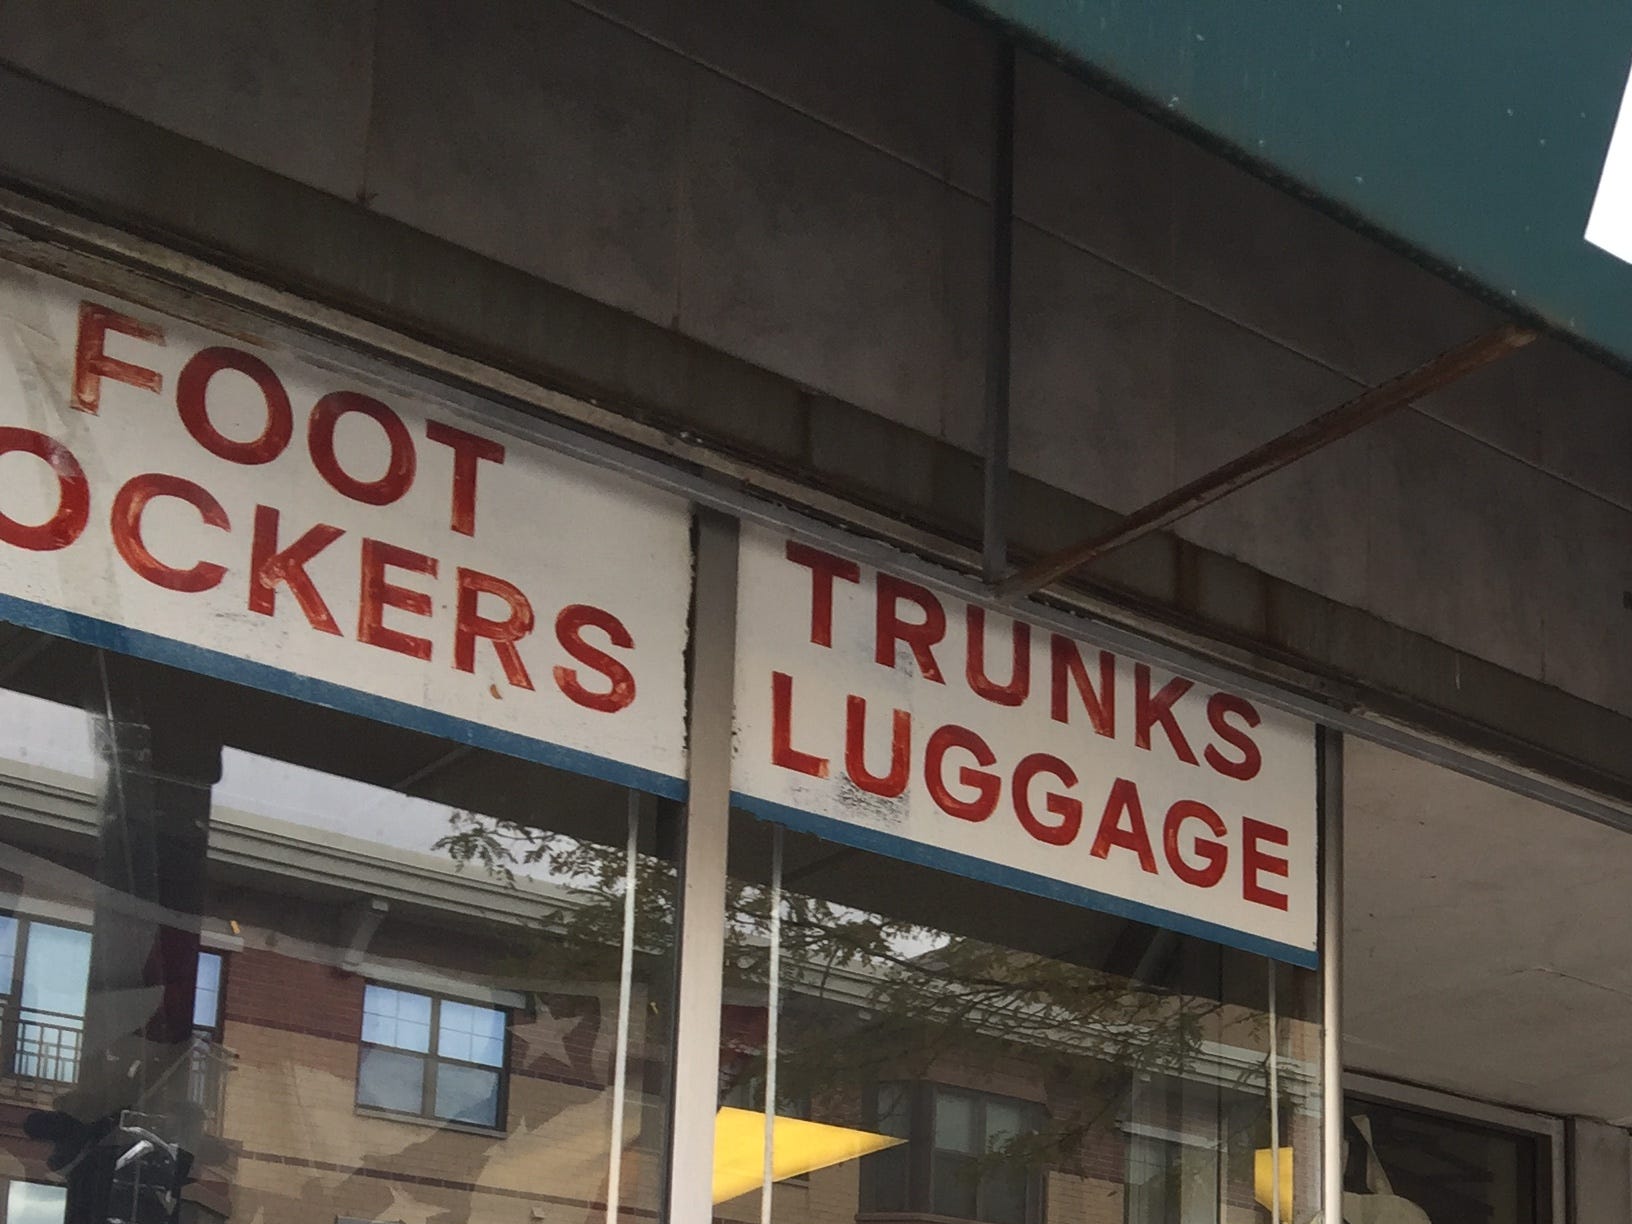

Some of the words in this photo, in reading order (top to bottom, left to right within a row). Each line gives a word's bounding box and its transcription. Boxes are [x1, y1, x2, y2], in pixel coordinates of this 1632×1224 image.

[70, 302, 505, 537] FOOT
[786, 540, 1262, 781] TRUNKS
[772, 671, 1289, 912] LUGGAGE
